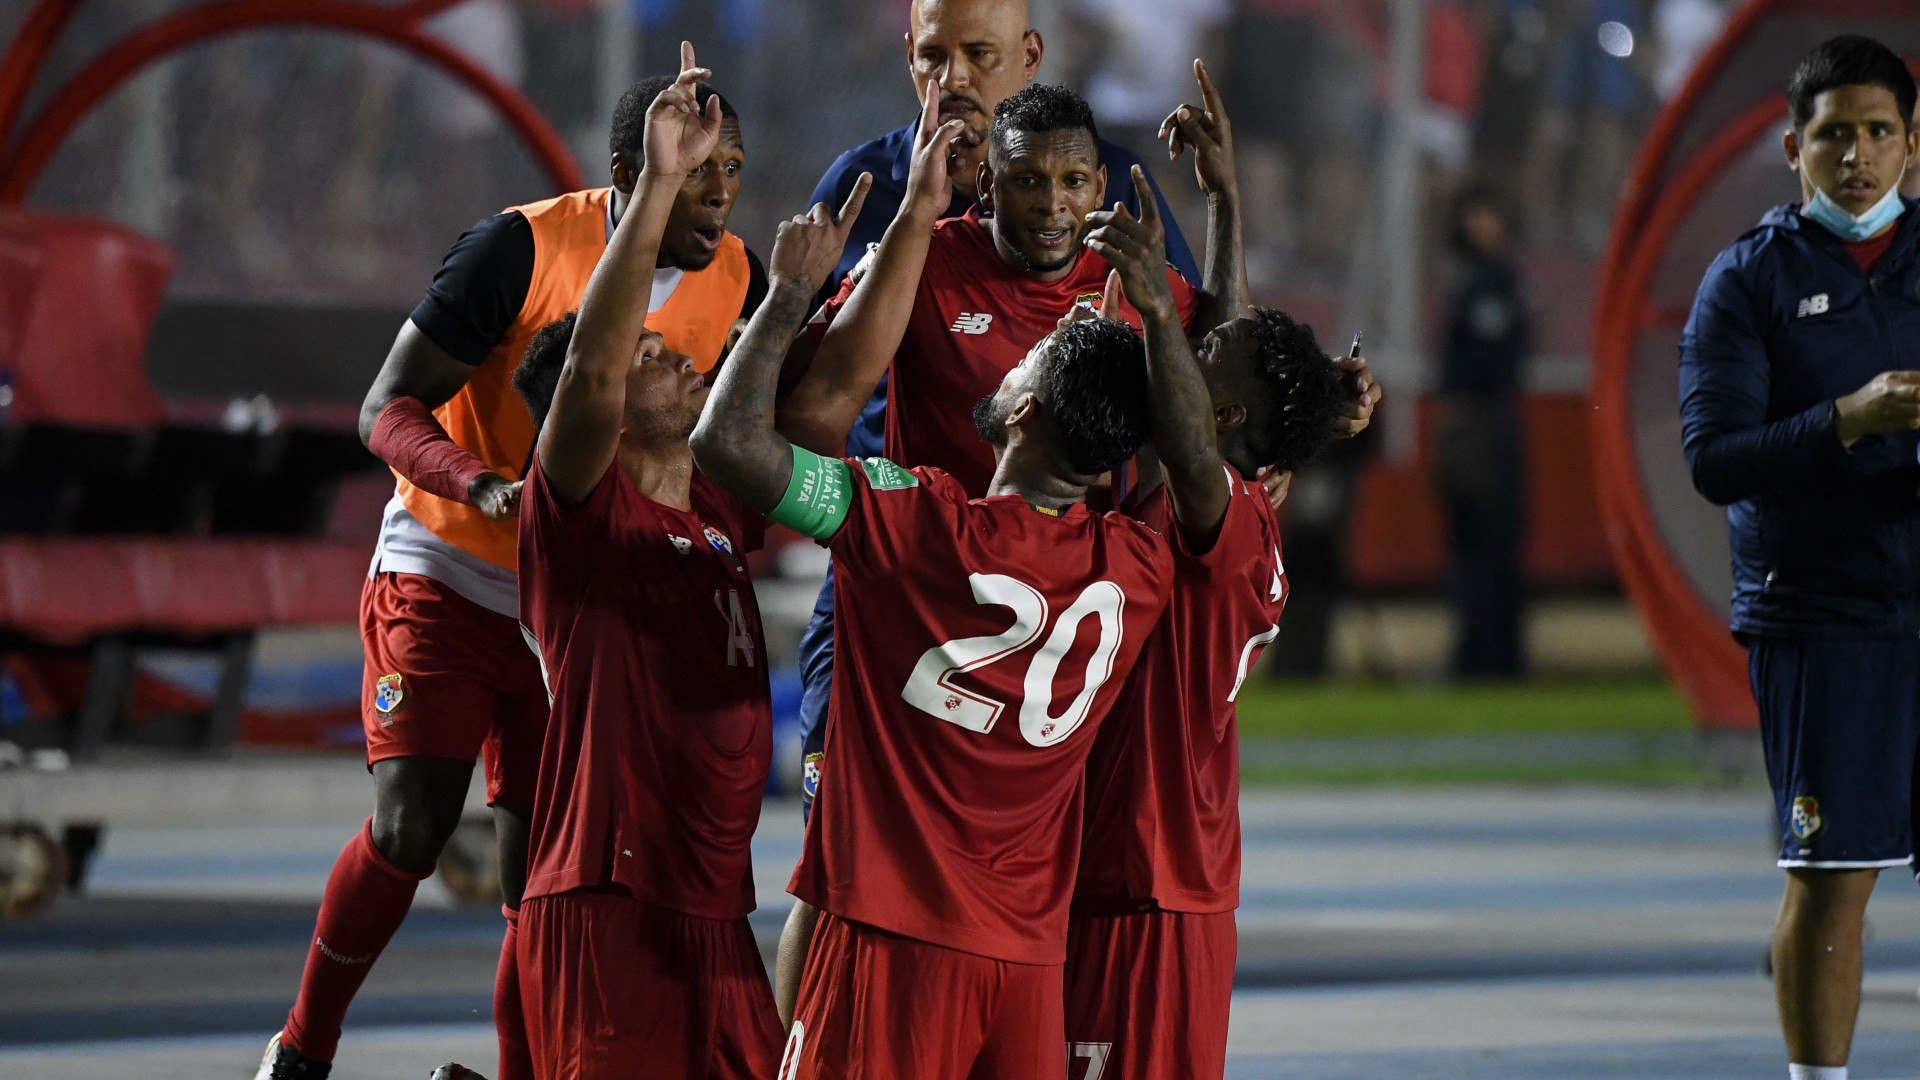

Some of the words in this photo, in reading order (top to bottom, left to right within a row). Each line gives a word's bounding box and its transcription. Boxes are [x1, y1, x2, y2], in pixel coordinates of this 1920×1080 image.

[1797, 293, 1829, 317] NB
[950, 312, 993, 335] NB
[797, 469, 816, 502] FIFA
[816, 458, 833, 510] OTBALL
[883, 457, 897, 485] OTBALL
[891, 465, 903, 485] ING
[826, 461, 842, 515] IVING
[900, 572, 1126, 747] 20
[1065, 1042, 1113, 1080] 7
